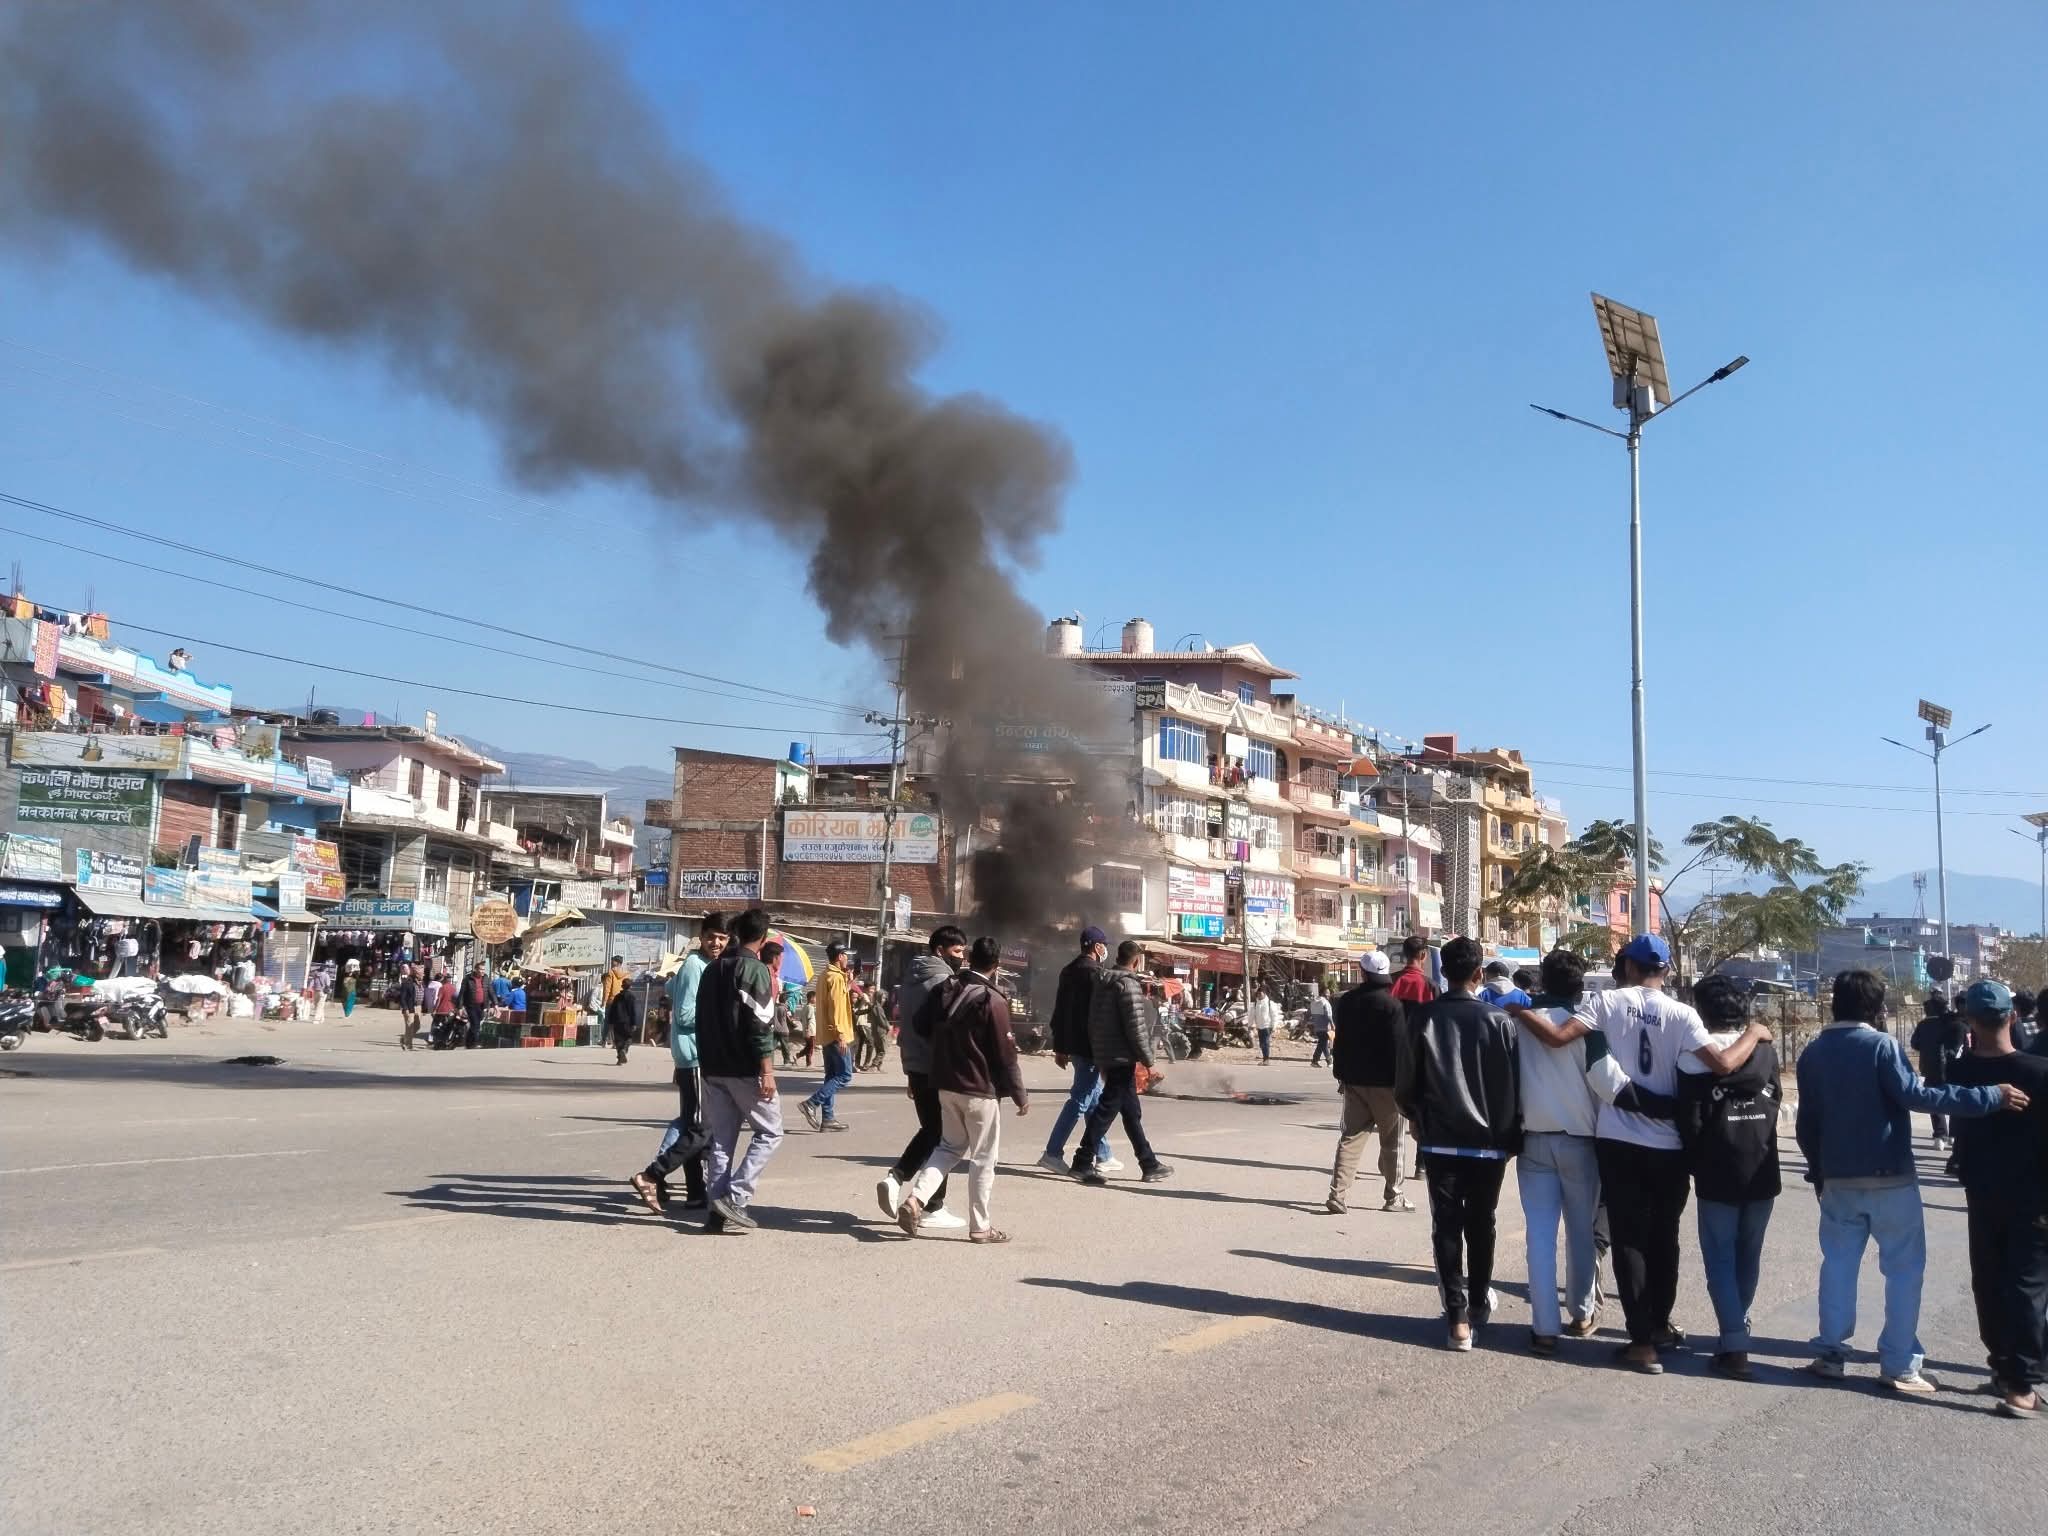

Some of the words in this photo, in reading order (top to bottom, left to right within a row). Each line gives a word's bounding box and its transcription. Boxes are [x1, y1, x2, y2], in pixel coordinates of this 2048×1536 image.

[1136, 693, 1165, 707] SPA
[107, 776, 146, 791] पसल
[18, 805, 78, 820] मनकामना
[788, 812, 860, 838] कोरियन
[1229, 818, 1248, 839] SPA
[1250, 879, 1286, 898] JAPAN
[1639, 1029, 1652, 1075] 6
